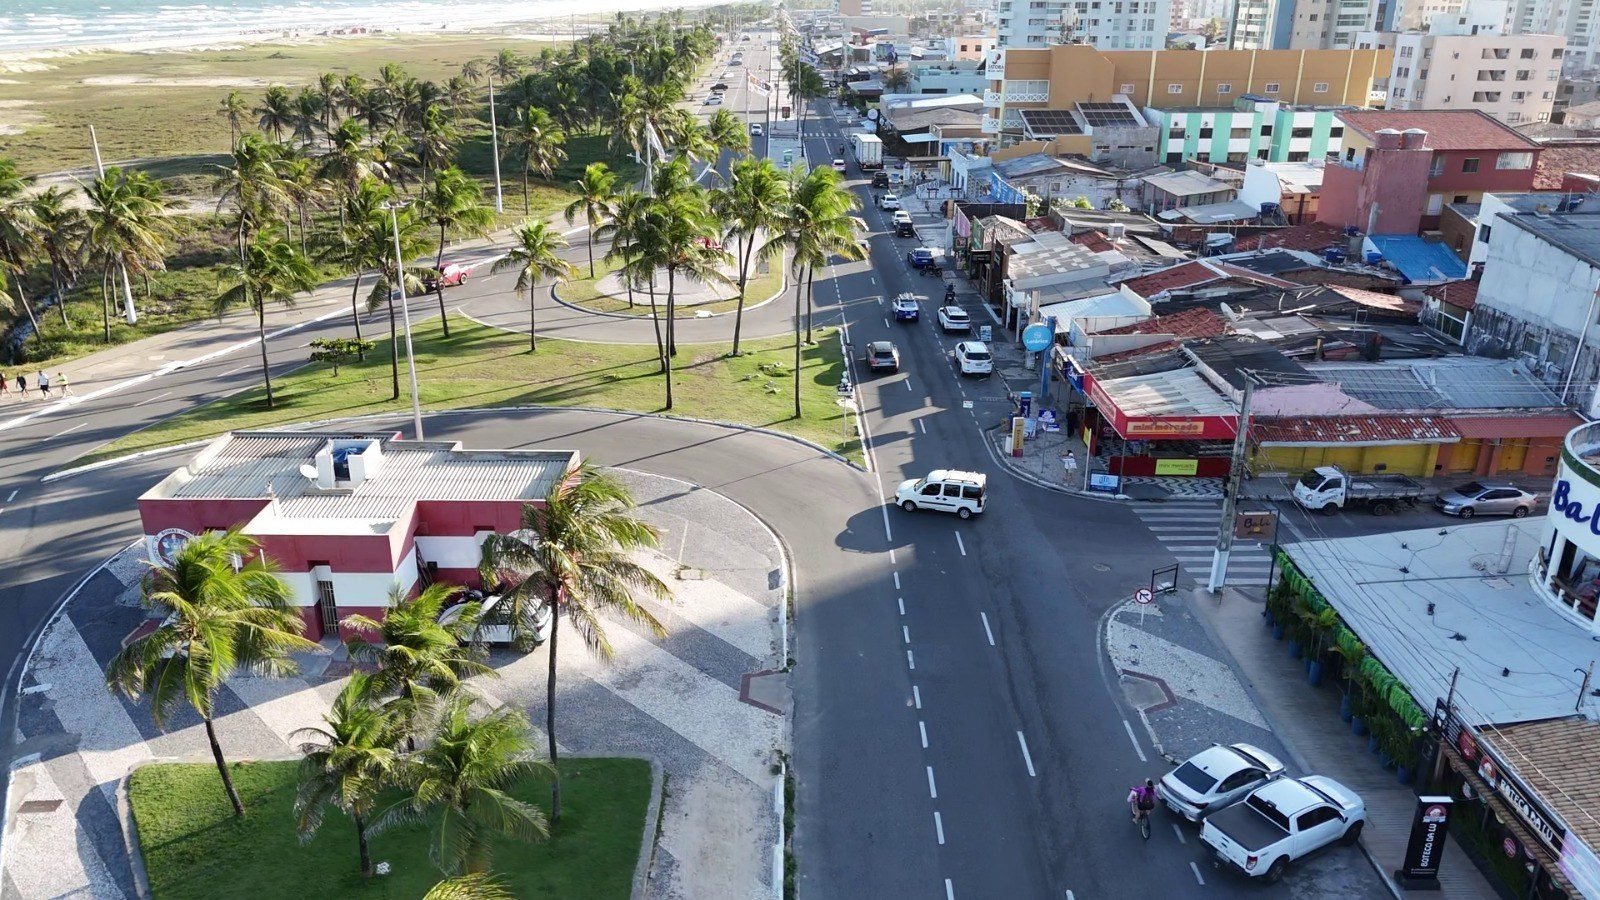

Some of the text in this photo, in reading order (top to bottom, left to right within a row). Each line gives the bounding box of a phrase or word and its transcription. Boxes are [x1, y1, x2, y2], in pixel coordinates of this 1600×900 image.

[1133, 423, 1199, 431] mini mercado
[1244, 517, 1271, 528] Bali
[1500, 779, 1529, 816] BOTECO
[1420, 823, 1437, 867] BOTECO DA LU
